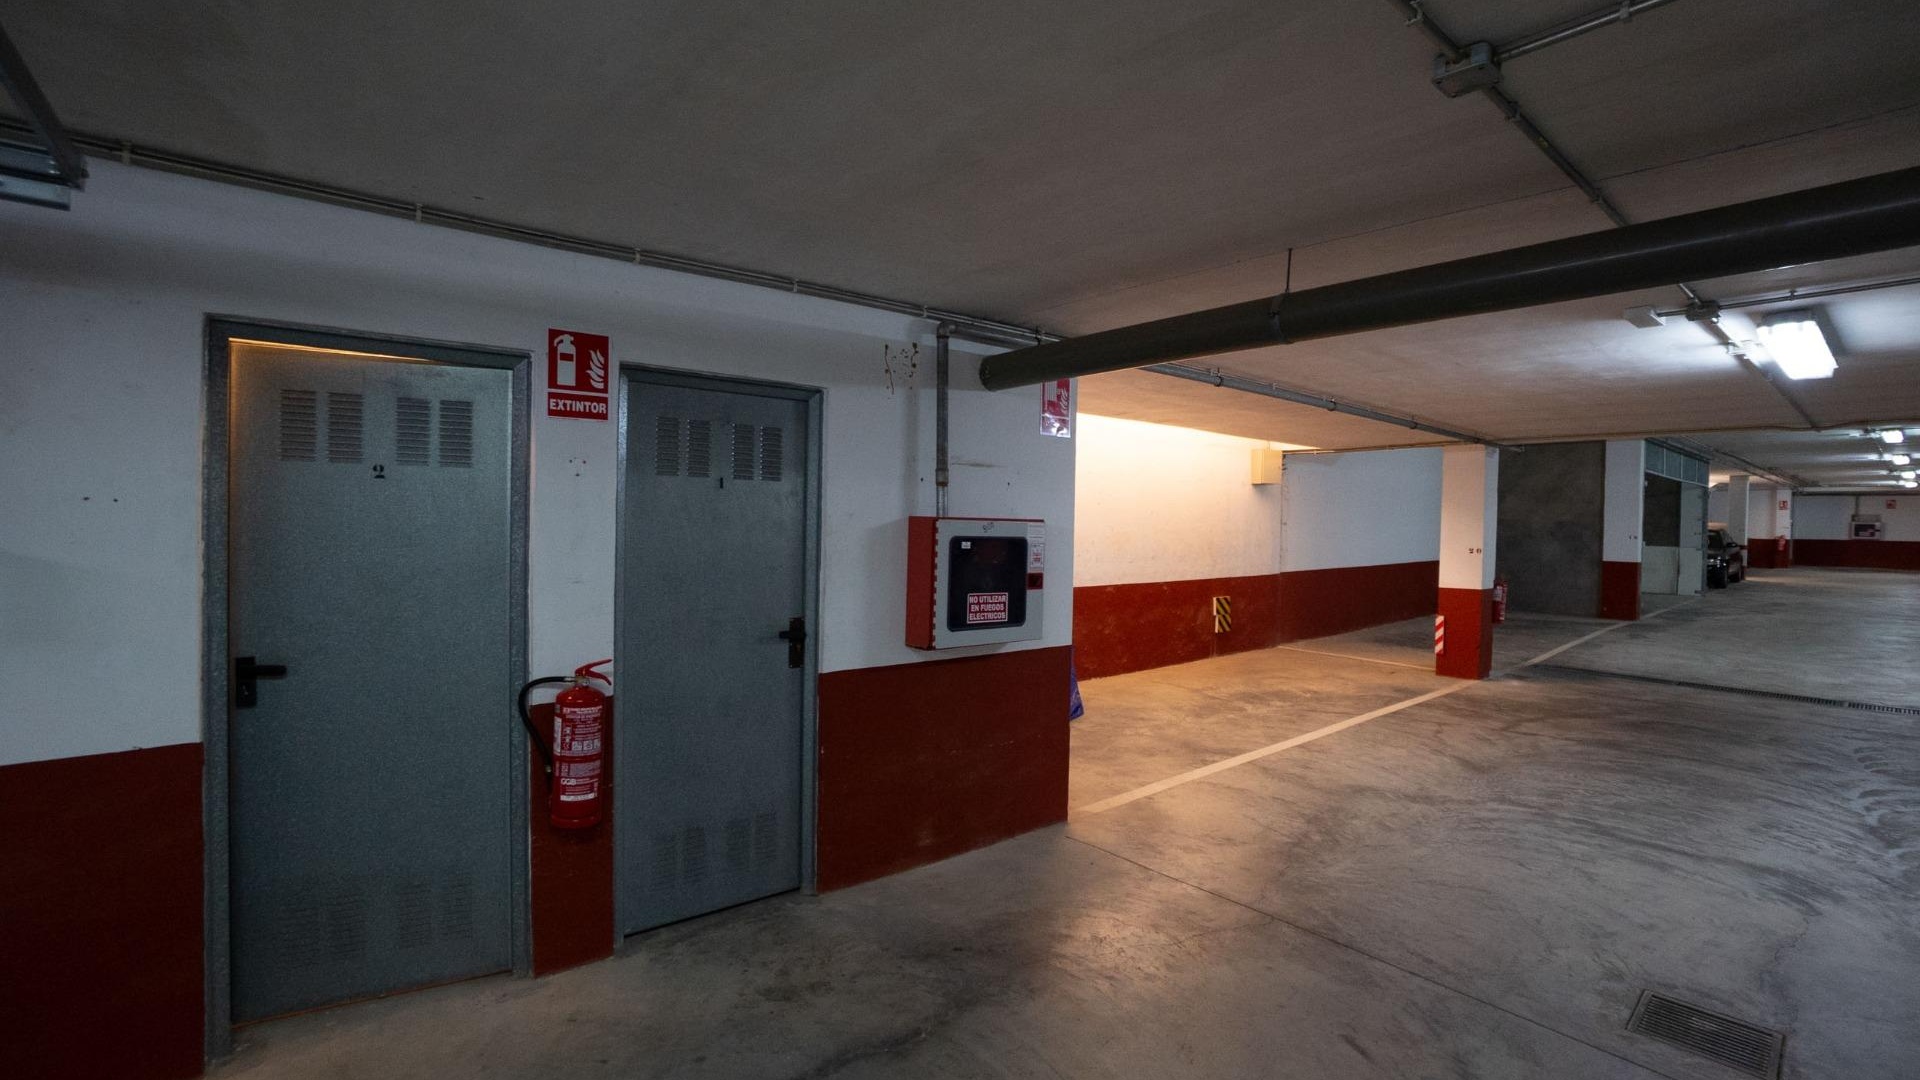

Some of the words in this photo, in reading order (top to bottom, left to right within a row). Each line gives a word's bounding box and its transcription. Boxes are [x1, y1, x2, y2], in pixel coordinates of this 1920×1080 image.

[550, 398, 607, 414] EXTINTOR
[372, 464, 385, 479] 2
[719, 477, 724, 489] 1
[970, 596, 979, 604] NO
[979, 595, 1006, 603] UTILIZAR
[971, 604, 979, 612] EN
[980, 603, 1005, 611] FUEGOS
[970, 612, 1006, 620] ELECTRICOS
